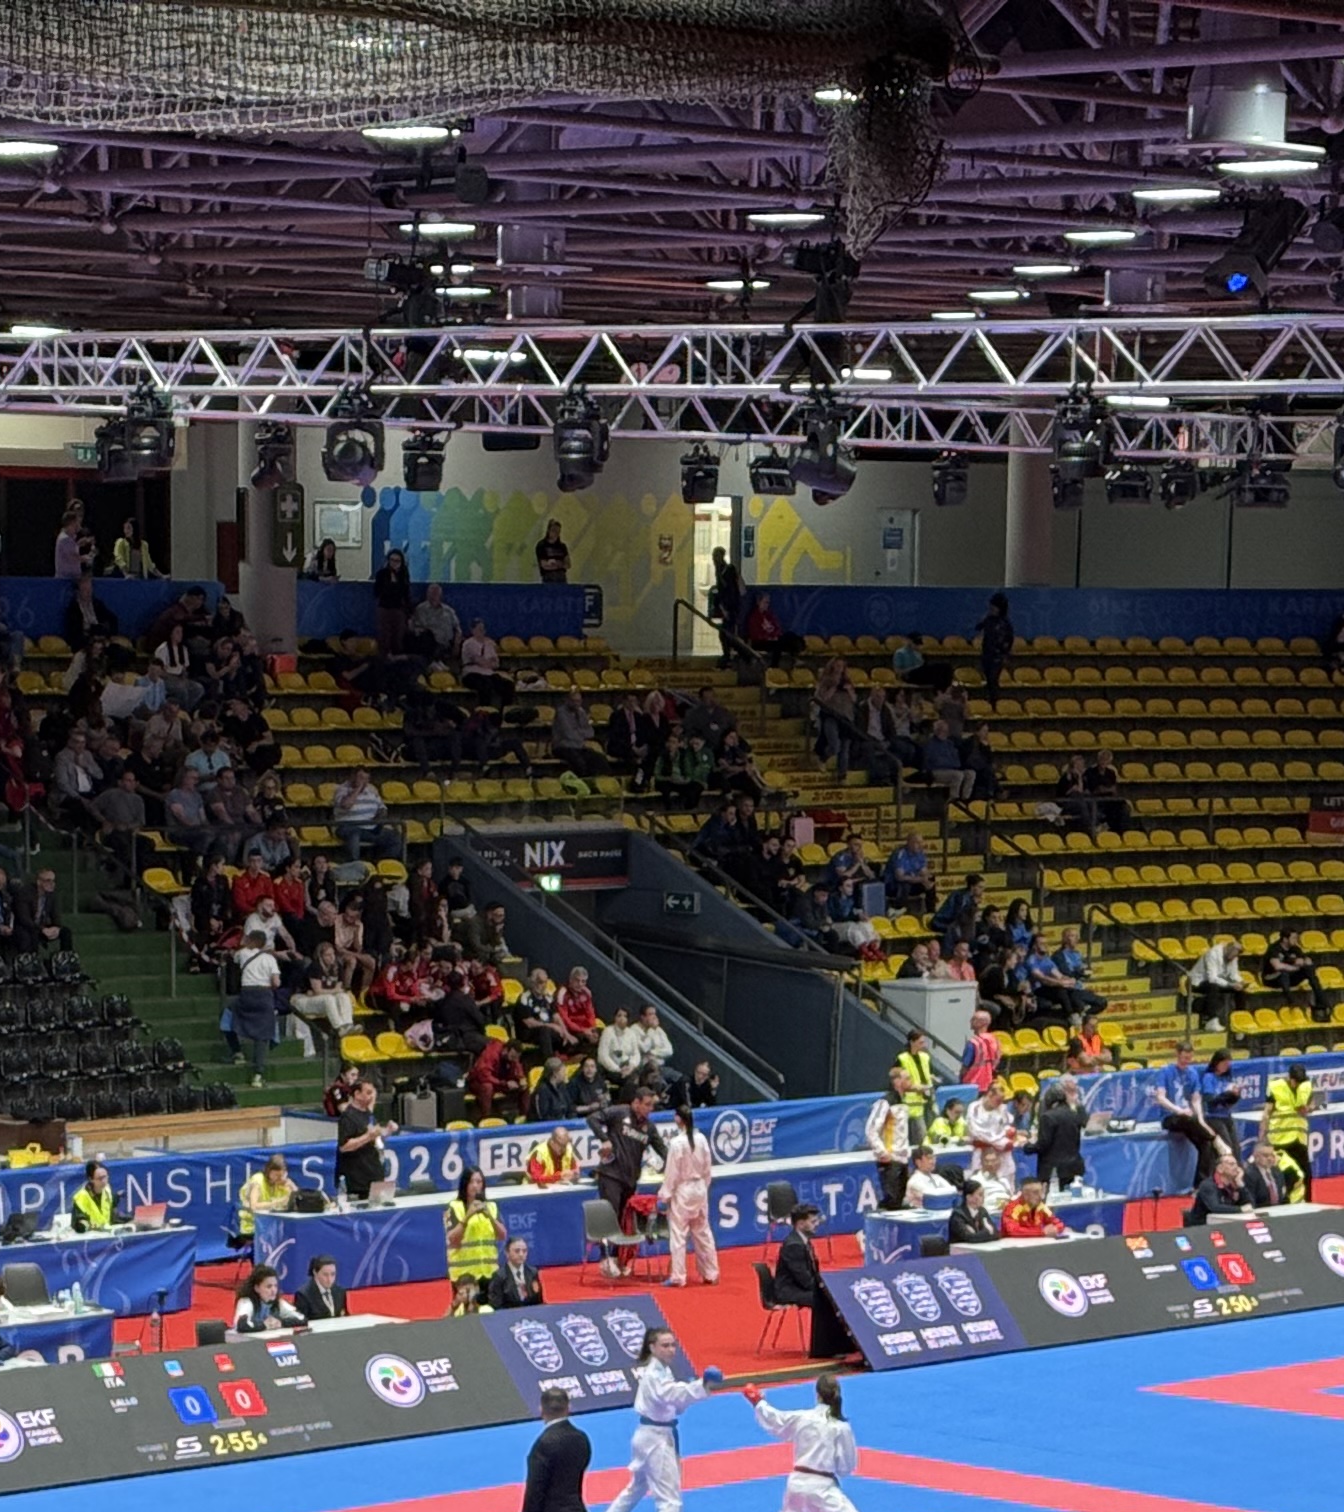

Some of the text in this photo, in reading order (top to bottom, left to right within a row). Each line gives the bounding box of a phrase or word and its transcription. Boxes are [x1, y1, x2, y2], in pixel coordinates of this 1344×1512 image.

[524, 841, 566, 868] NIX
[751, 1117, 778, 1136] EKF
[276, 1355, 301, 1368] LUX
[416, 1357, 453, 1378] EKF
[104, 1377, 125, 1389] ITA
[185, 1396, 201, 1416] 0
[235, 1389, 251, 1409] 0
[16, 1407, 57, 1428] EKF
